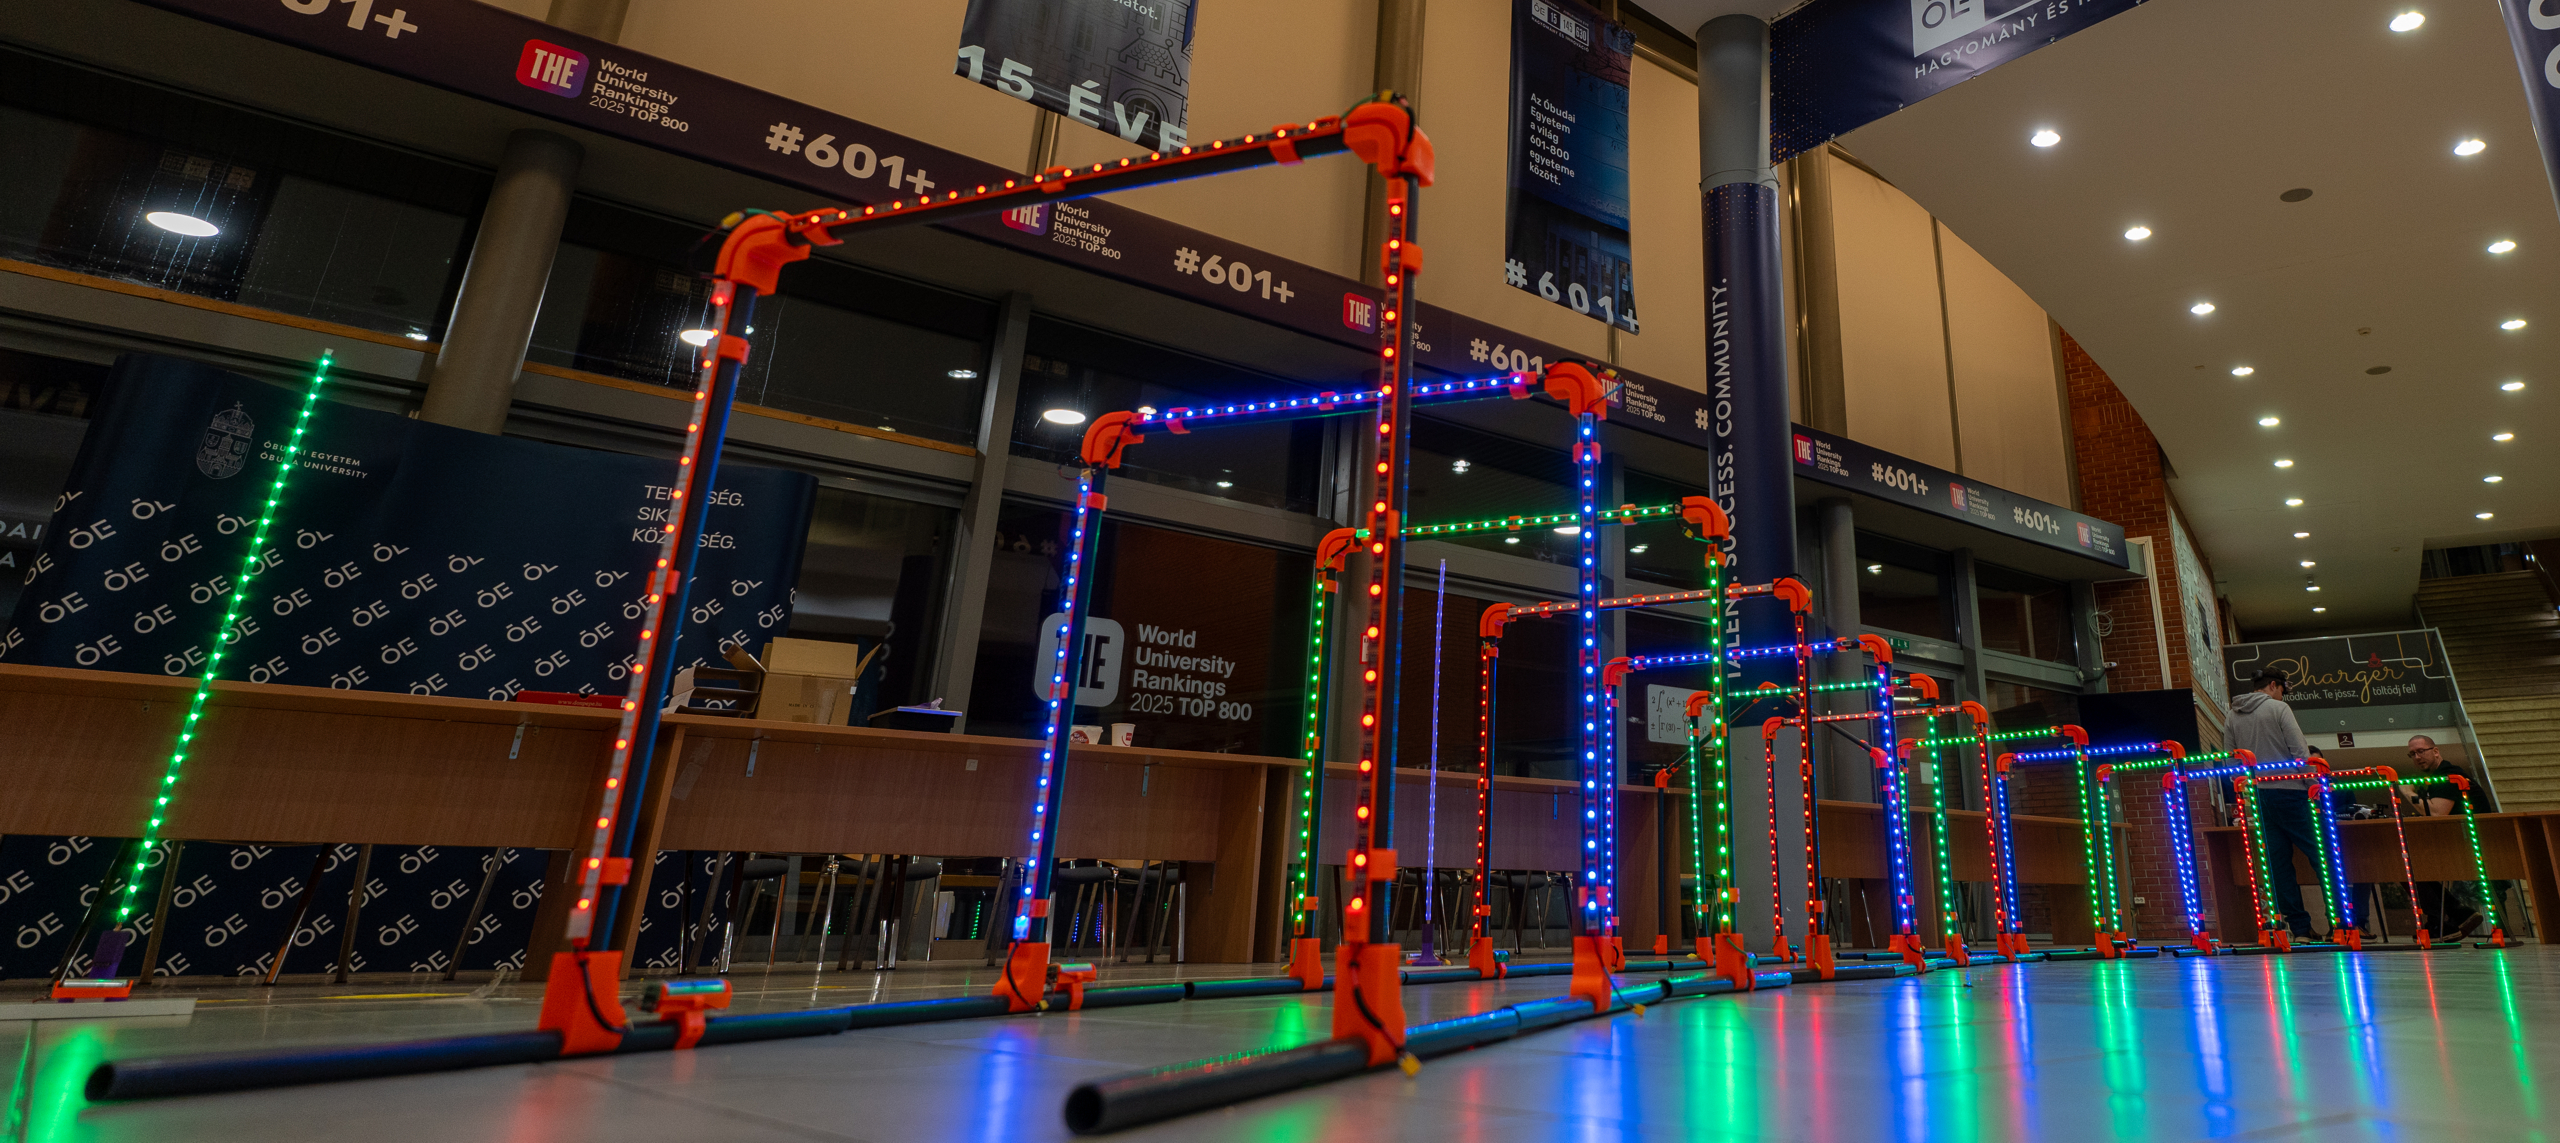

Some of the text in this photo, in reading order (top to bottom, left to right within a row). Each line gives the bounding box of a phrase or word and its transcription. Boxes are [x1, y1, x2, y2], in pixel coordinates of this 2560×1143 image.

[281, 0, 418, 39] 1+
[1551, 12, 1558, 25] 15
[1576, 26, 1587, 41] 630
[1915, 0, 2069, 79] HAGYOMÁNY ÉS
[530, 48, 579, 89] THE
[600, 58, 648, 82] World
[958, 45, 1034, 101] 15
[592, 83, 669, 114] Rankings
[596, 70, 678, 105] University
[589, 95, 689, 132] 2025 TOP 800
[1530, 93, 1576, 124] Az Óbudai
[1530, 106, 1571, 134] Egyetem
[1530, 121, 1559, 145] a világ
[765, 121, 936, 195] #601+
[1530, 134, 1570, 161] 601-800
[1529, 161, 1561, 186] között.
[1530, 150, 1575, 178] egyeteme
[1011, 203, 1042, 228] THE
[1055, 211, 1111, 237] University
[1057, 201, 1089, 219] World
[1052, 232, 1121, 260] 2025 TOP 800
[1053, 221, 1106, 245] Rankings
[1174, 246, 1294, 303] #601+
[1504, 258, 1639, 332] #601+
[1348, 299, 1371, 328] THE
[1416, 340, 1431, 352] 800
[1469, 338, 1543, 375] #601
[1601, 378, 1619, 403] THE
[1625, 380, 1644, 392] World
[1625, 388, 1658, 405] University
[1626, 396, 1656, 412] Rankings
[1626, 405, 1666, 423] 2025 TOP 800
[263, 440, 361, 467] ÓBUAI EGYETEM
[1796, 439, 1811, 461] THE
[1815, 440, 1831, 450] World
[1816, 447, 1842, 461] University
[260, 451, 368, 479] ÓBUA UNIVERSITY
[1712, 278, 1741, 678] TALEN. SUCCESS. COMMUNITY.
[1871, 462, 1929, 495] #601+
[1952, 487, 1966, 507] THE
[2013, 506, 2060, 535] #601+
[631, 527, 737, 549] KÖZSÉG.
[1138, 623, 1196, 648] World
[1135, 646, 1236, 678] University
[1133, 669, 1226, 699] Rankings
[2322, 689, 2333, 698] Te
[2402, 684, 2417, 693] fel!
[1130, 692, 1252, 721] 2025 TOP 800
